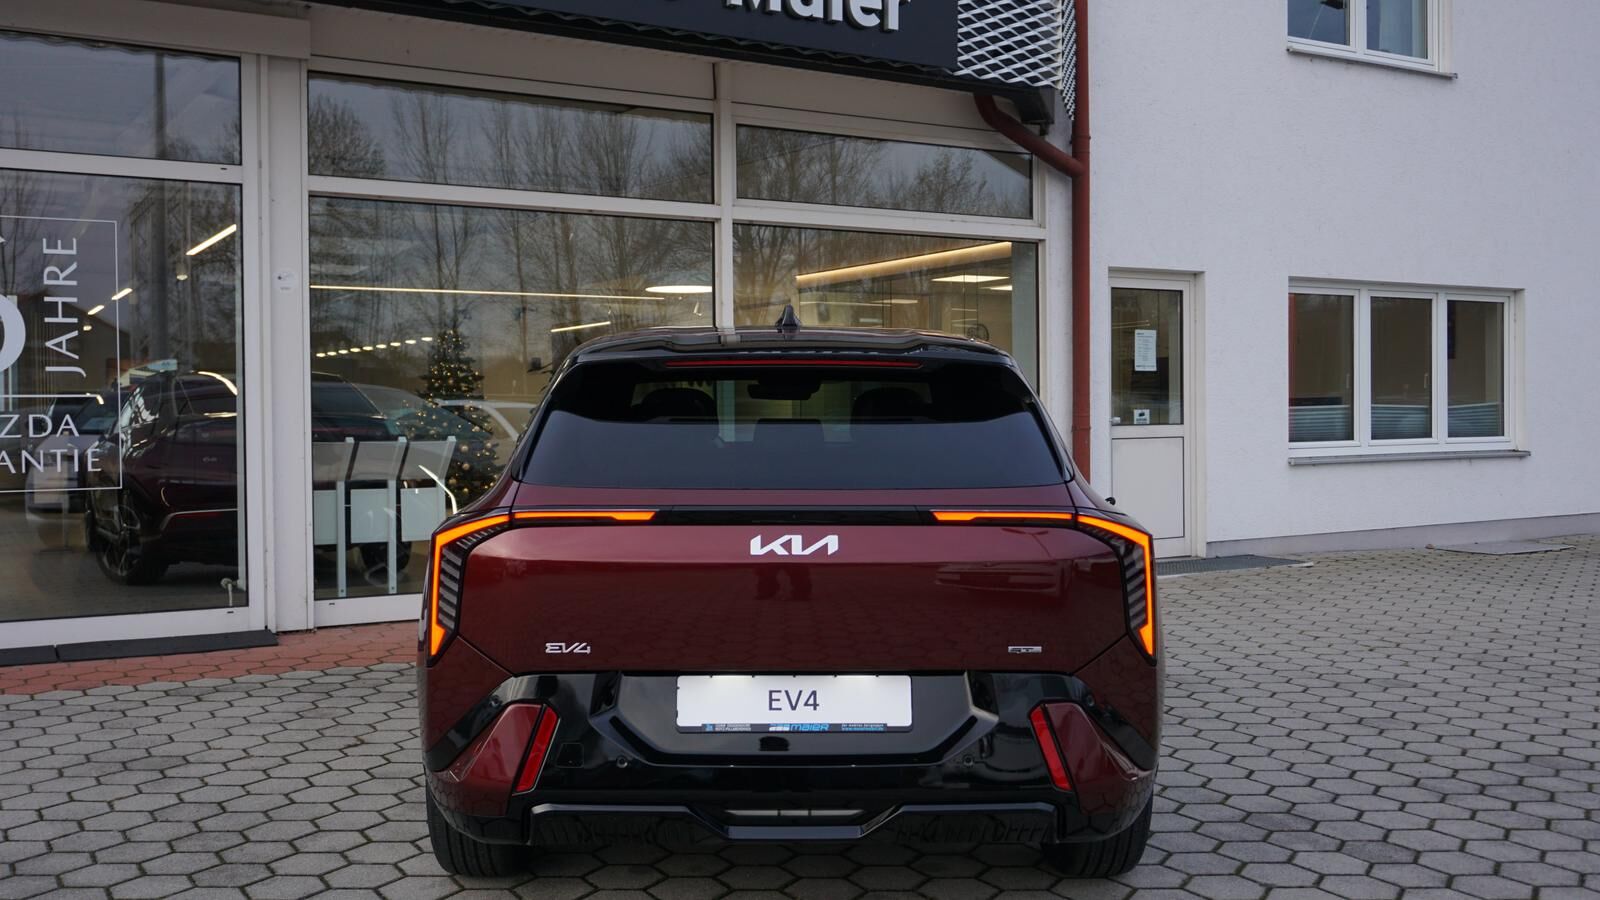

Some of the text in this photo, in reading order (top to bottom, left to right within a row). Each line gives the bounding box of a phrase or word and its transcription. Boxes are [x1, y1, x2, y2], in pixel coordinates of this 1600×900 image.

[725, 0, 909, 31] aier
[41, 237, 87, 378] JAHRE
[750, 534, 839, 556] KIA
[545, 642, 591, 654] EV4
[768, 689, 820, 711] EV4
